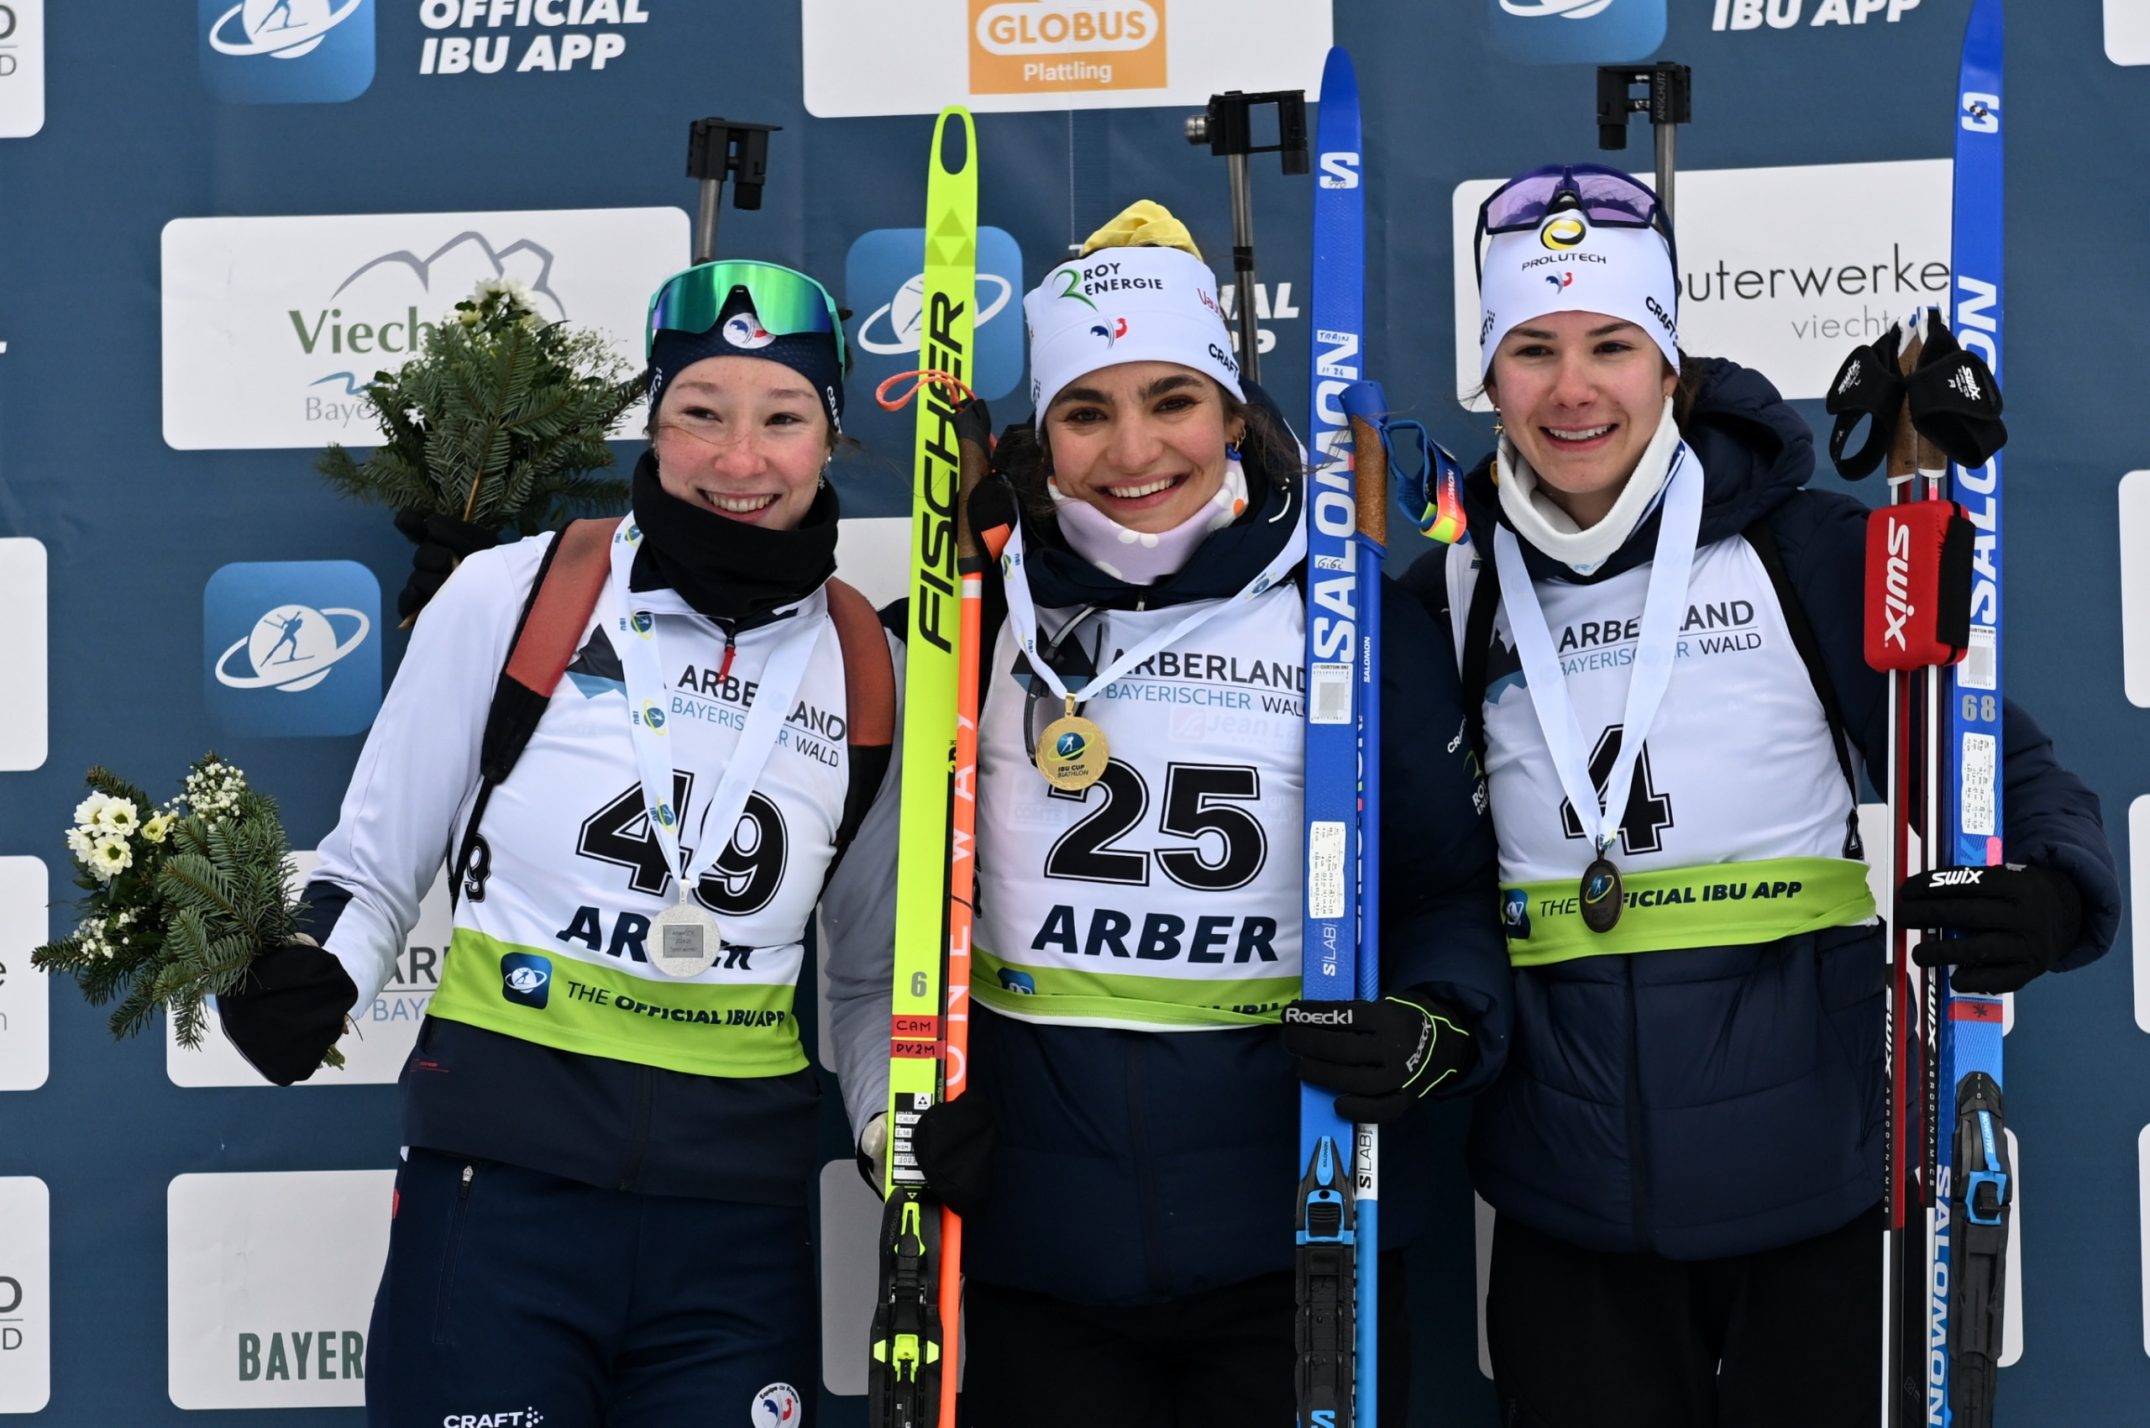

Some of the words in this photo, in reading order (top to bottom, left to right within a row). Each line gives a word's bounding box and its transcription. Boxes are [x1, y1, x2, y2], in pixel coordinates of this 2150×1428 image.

[419, 0, 649, 29] OFFICIAL
[988, 11, 1146, 44] GLOBUS
[1712, 0, 1800, 31] IBU
[419, 36, 510, 75] IBU
[516, 33, 626, 72] APP
[1024, 61, 1112, 83] Plattling
[1083, 262, 1121, 281] ROY
[1522, 253, 1607, 271] PROLUTECH
[1677, 243, 1950, 301] uterwerke
[1084, 278, 1163, 297] ENERGIE
[288, 306, 437, 354] Viech
[1646, 296, 1677, 339] CRAFT
[1208, 343, 1239, 378] CRAFT
[919, 291, 964, 654] FISCHER
[1314, 330, 1358, 663] SALOMON
[1699, 633, 1762, 655] WALD
[1106, 683, 1251, 709] BAYERISCHER
[1261, 695, 1305, 717] WAL
[1961, 694, 1996, 722] 68
[796, 735, 839, 768] WALD
[1560, 724, 1674, 855] 4
[1044, 757, 1268, 892] 25
[575, 769, 788, 917] 49
[1539, 897, 1577, 917] THE
[1703, 882, 1747, 902] IBU
[1752, 881, 1802, 898] APP
[1031, 904, 1278, 963] ARBER
[911, 971, 927, 997] 6
[567, 980, 611, 1005] THE
[615, 995, 721, 1025] OFFICIAL
[725, 1010, 756, 1027] IBU
[755, 1011, 786, 1027] APP
[1286, 1008, 1352, 1024] Roeckl
[896, 1020, 931, 1032] CAM
[1929, 1165, 1950, 1426] SALOMON
[443, 1411, 523, 1428] CRAFT
